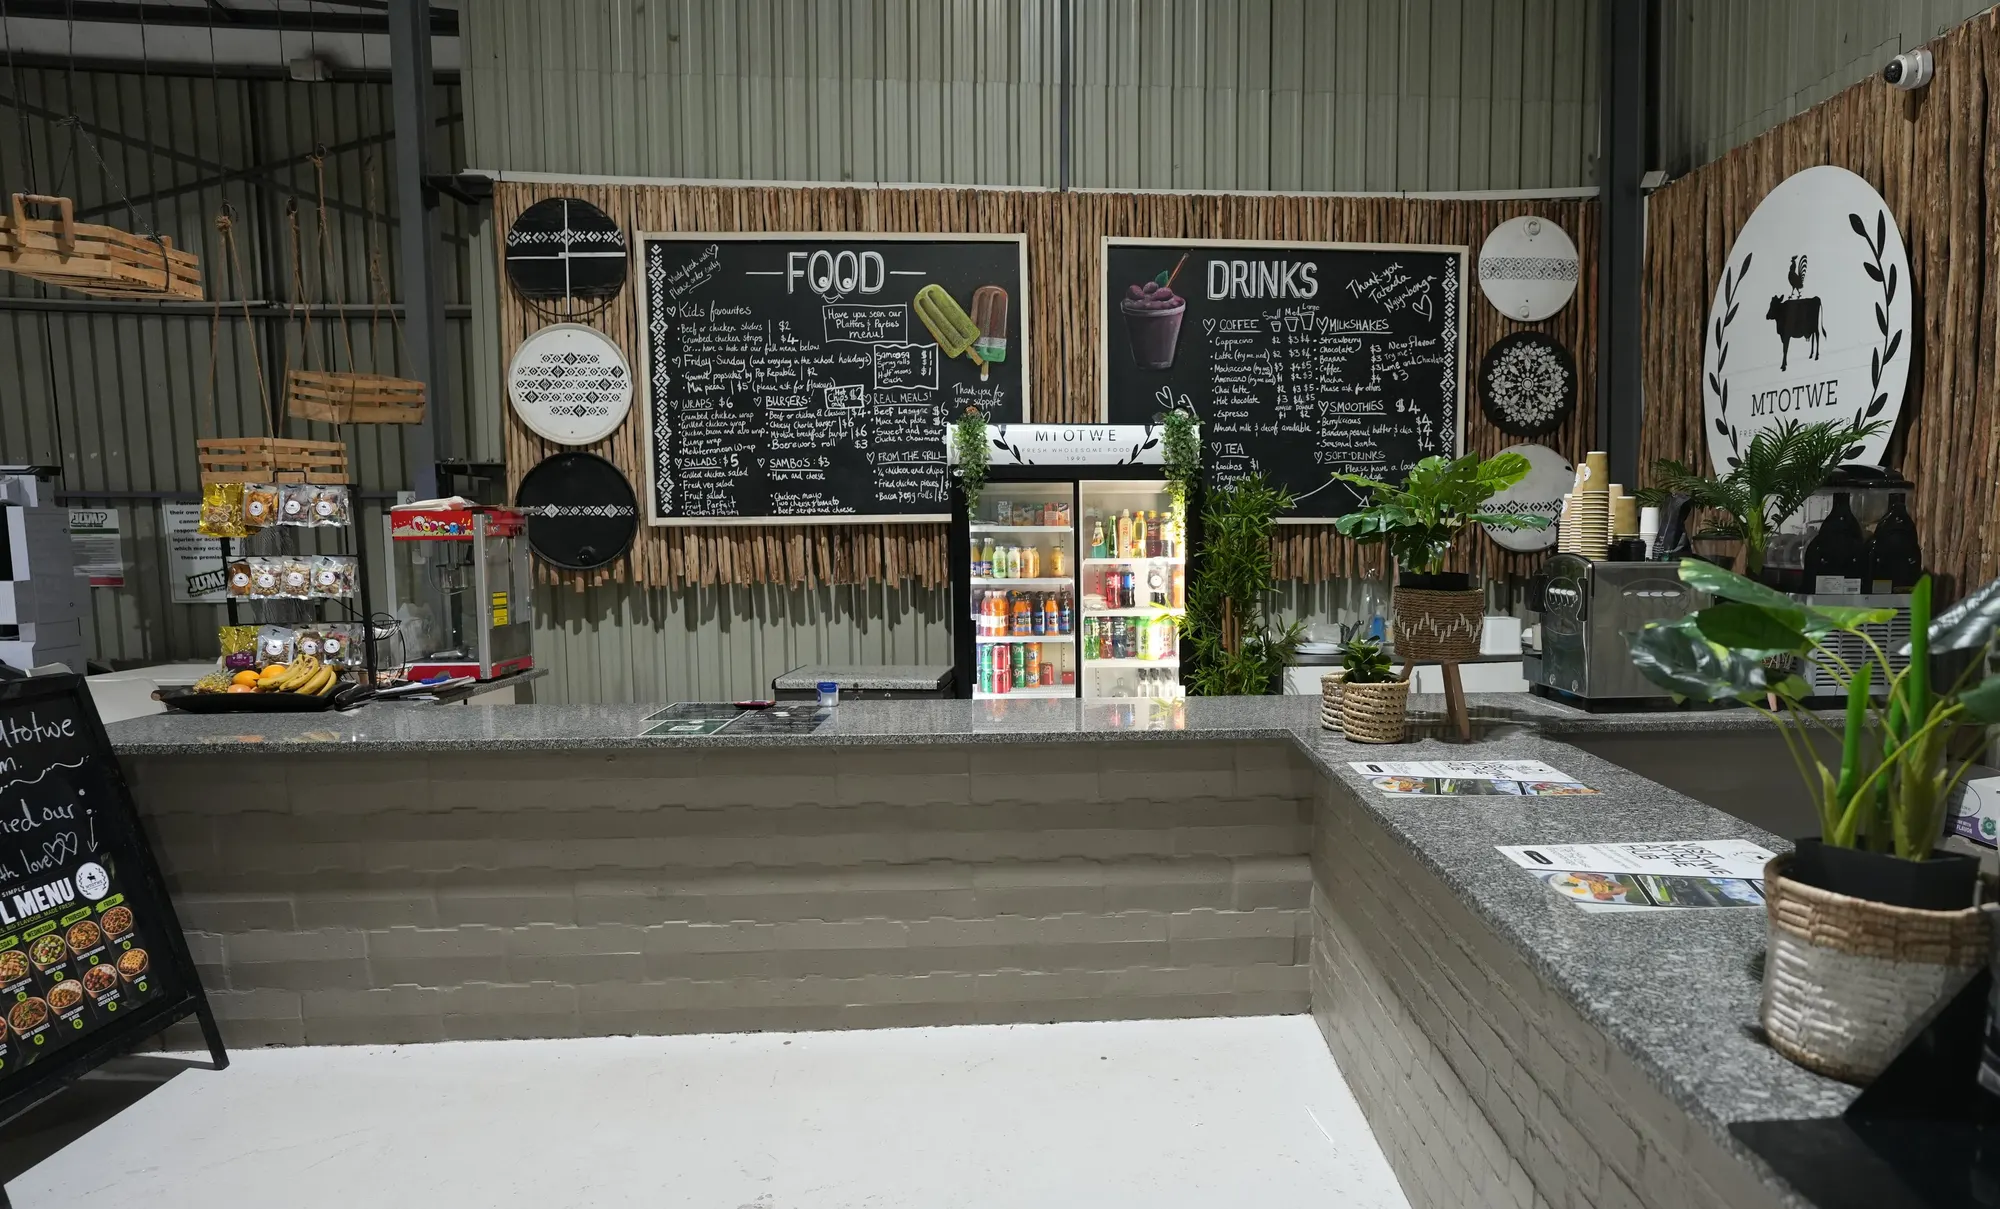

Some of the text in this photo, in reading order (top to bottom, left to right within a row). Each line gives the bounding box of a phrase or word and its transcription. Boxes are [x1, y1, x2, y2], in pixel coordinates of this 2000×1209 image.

[787, 250, 884, 294] FOOD
[1207, 260, 1318, 300] DRINKS
[1368, 275, 1411, 304] Tatenda
[678, 300, 751, 322] Kids favourites
[828, 309, 849, 320] Have
[853, 311, 866, 321] you
[869, 310, 885, 318] seen
[1220, 303, 1320, 330] COFFEE Med Large
[681, 320, 791, 335] Beef chicken $2
[875, 319, 900, 328] Parties
[1329, 319, 1389, 332] MILKSHAKES
[682, 332, 799, 345] Crumbed chicken strips $4
[1272, 336, 1281, 345] $2
[1319, 336, 1361, 351] Strawberry
[1389, 335, 1436, 350] New flavour
[702, 344, 716, 352] have
[726, 344, 738, 352] look
[765, 343, 778, 355] full
[800, 341, 820, 351] below
[1320, 345, 1354, 354] Chocolate
[801, 354, 834, 364] the school
[1214, 350, 1282, 360] Latte $2
[1403, 357, 1416, 367] and
[755, 367, 818, 383] Pop Republic $2
[1320, 364, 1342, 375] Coffee
[1320, 375, 1343, 383] Mocha
[737, 380, 804, 394] $5 for
[994, 384, 1004, 397] for
[1215, 385, 1250, 394] Chai latte
[1320, 383, 1364, 395] Please for
[719, 397, 733, 408] $6
[873, 391, 932, 405] REAL MEALS!
[954, 397, 1002, 408] your support
[1216, 395, 1260, 405] Hot chocolate
[1751, 379, 1838, 417] MTOTWE
[874, 402, 949, 416] Beef $6
[1330, 399, 1421, 414] SMOOTHIES $4
[681, 411, 754, 422] Crumbed chicken wrap
[769, 411, 784, 421] Beef
[894, 416, 907, 424] and
[1217, 410, 1248, 421] Espresso
[1416, 413, 1433, 425] $4
[706, 420, 728, 428] chicken
[842, 417, 854, 428] $6
[1213, 422, 1251, 433] Almond milk
[855, 424, 867, 437] $6
[876, 425, 904, 435] Sweet
[905, 425, 920, 434] and
[1372, 424, 1392, 434] butter
[772, 438, 868, 450] Boerewors roll $3
[1225, 443, 1244, 454] TEA
[1418, 435, 1435, 451] $4
[682, 446, 732, 455] Mediterranean
[878, 450, 919, 461] FROM THE
[723, 454, 739, 467] $5
[818, 455, 830, 467] $3
[1216, 460, 1242, 471] Rooibos
[728, 467, 749, 477] salad
[926, 465, 944, 478] chips
[1345, 464, 1388, 473] Please have
[683, 479, 734, 494] Fresh veg salad
[879, 479, 918, 488] Fried chicken
[684, 490, 727, 501] Fruit salad
[879, 492, 915, 503] Bacon egg
[71, 512, 107, 524] JUMP
[43, 804, 74, 820] our
[1682, 843, 1725, 859] VISIT
[20, 849, 52, 874] love
[2, 885, 26, 898] SIMPLE
[13, 877, 75, 918] MENU
[103, 897, 118, 907] FRIDAY
[43, 908, 58, 917] MADE
[65, 909, 88, 922] THURSDAY
[26, 922, 54, 938] WEDNESDAY
